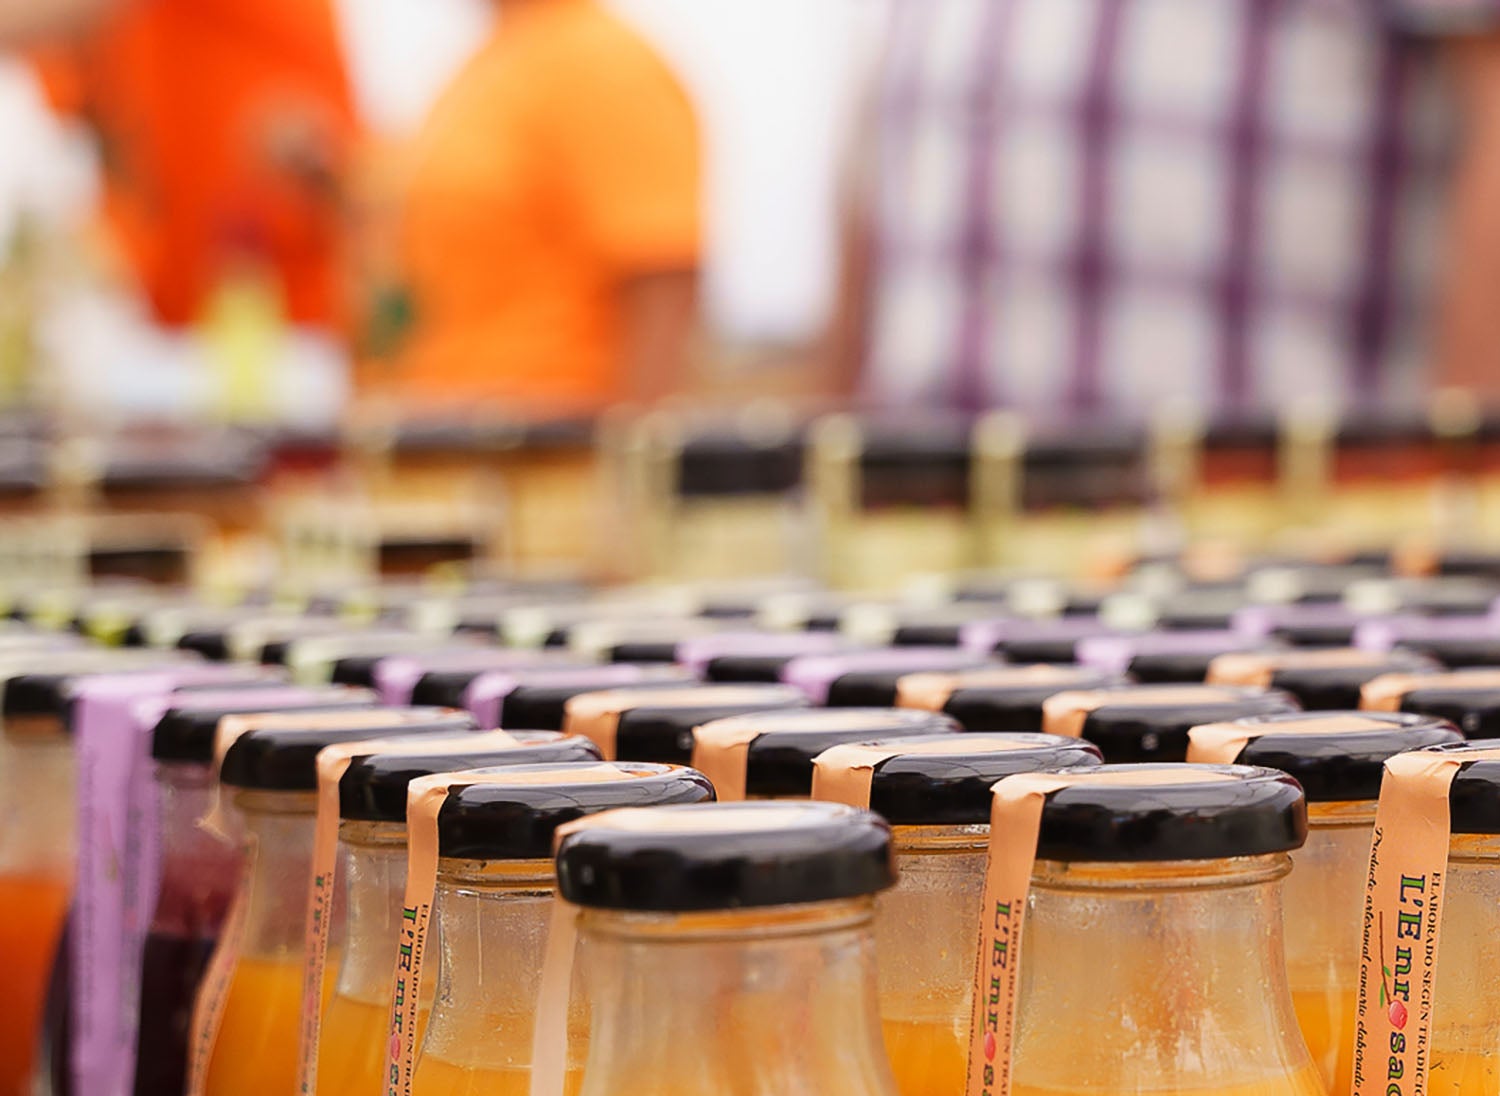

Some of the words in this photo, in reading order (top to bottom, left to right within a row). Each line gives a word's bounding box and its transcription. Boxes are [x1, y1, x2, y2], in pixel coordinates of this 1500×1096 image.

[1368, 826, 1384, 894] Producto
[1424, 871, 1441, 968] ELABORADO
[1418, 970, 1433, 1017] SEGÚN
[1354, 1020, 1367, 1089] elaborado
